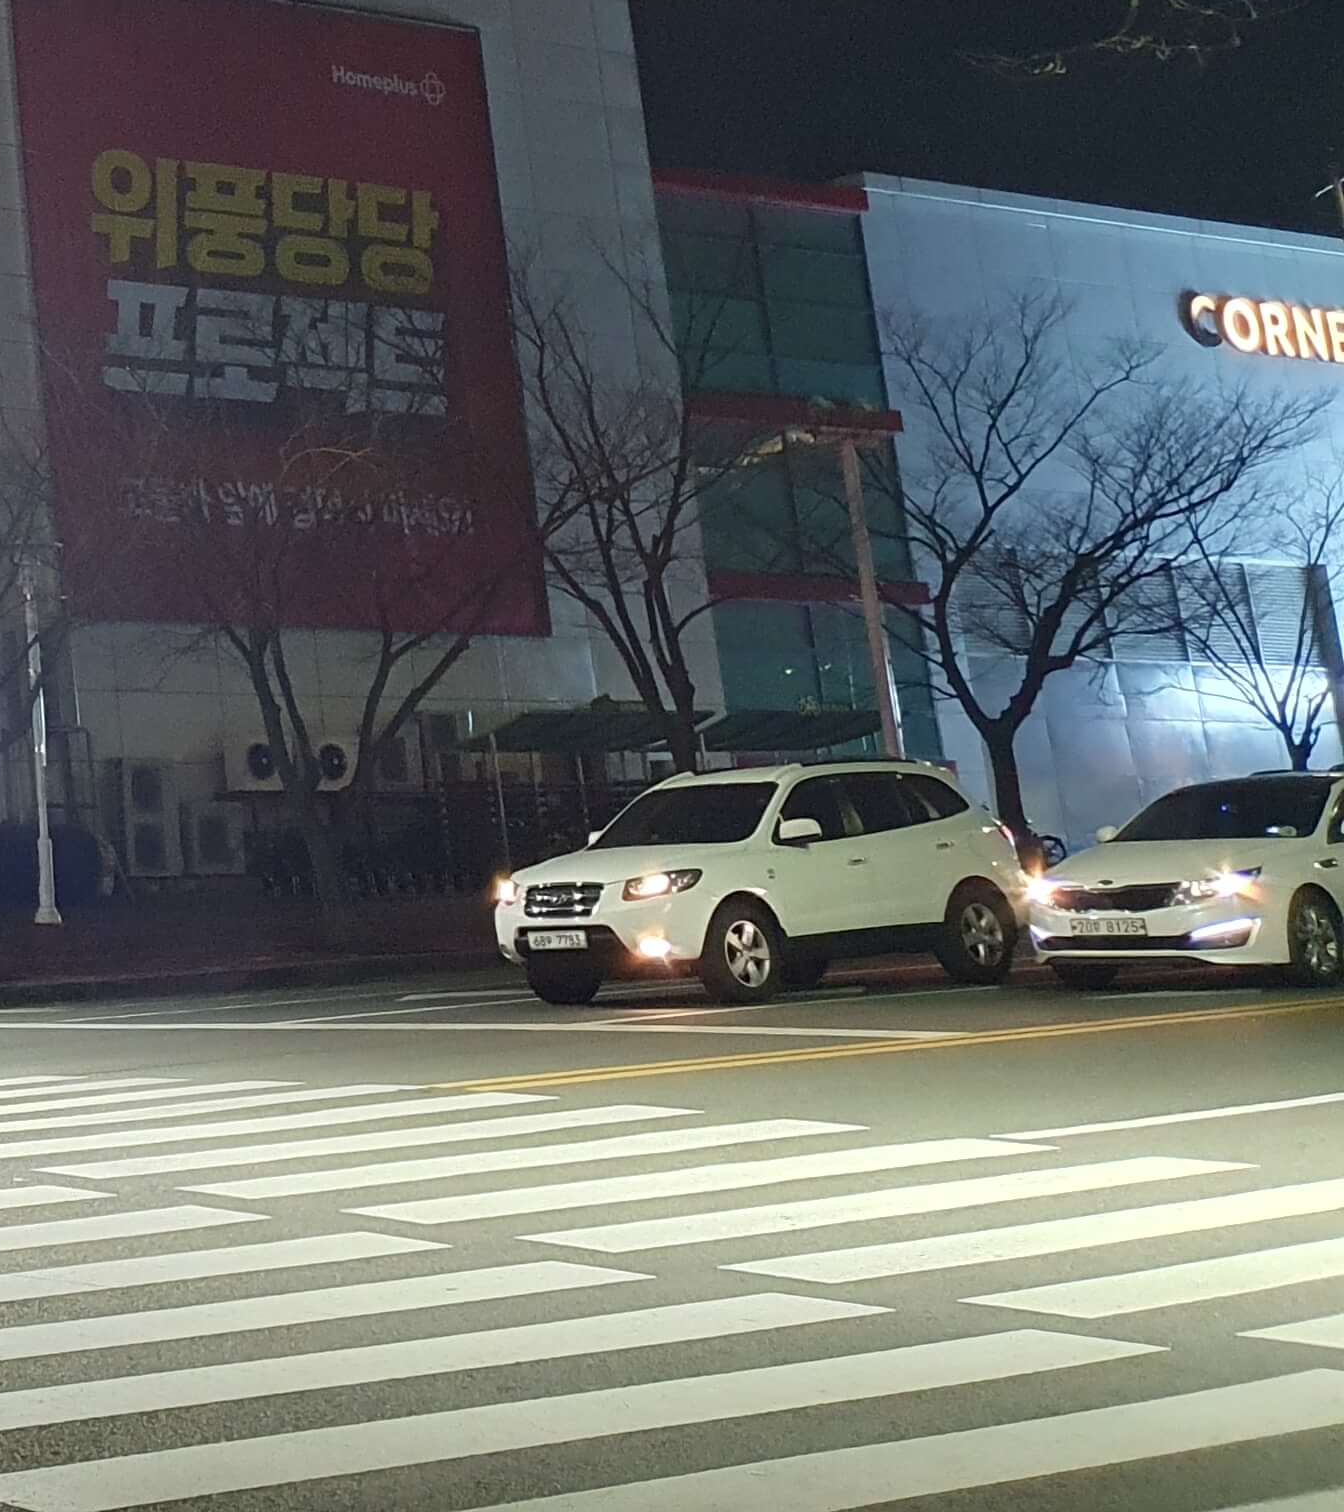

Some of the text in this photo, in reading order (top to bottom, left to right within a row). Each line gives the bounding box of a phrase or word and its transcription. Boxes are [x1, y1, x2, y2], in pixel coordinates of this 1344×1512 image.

[331, 65, 419, 96] Homeplus
[92, 149, 440, 294] 위풍당당
[103, 279, 448, 416] 프로젝트
